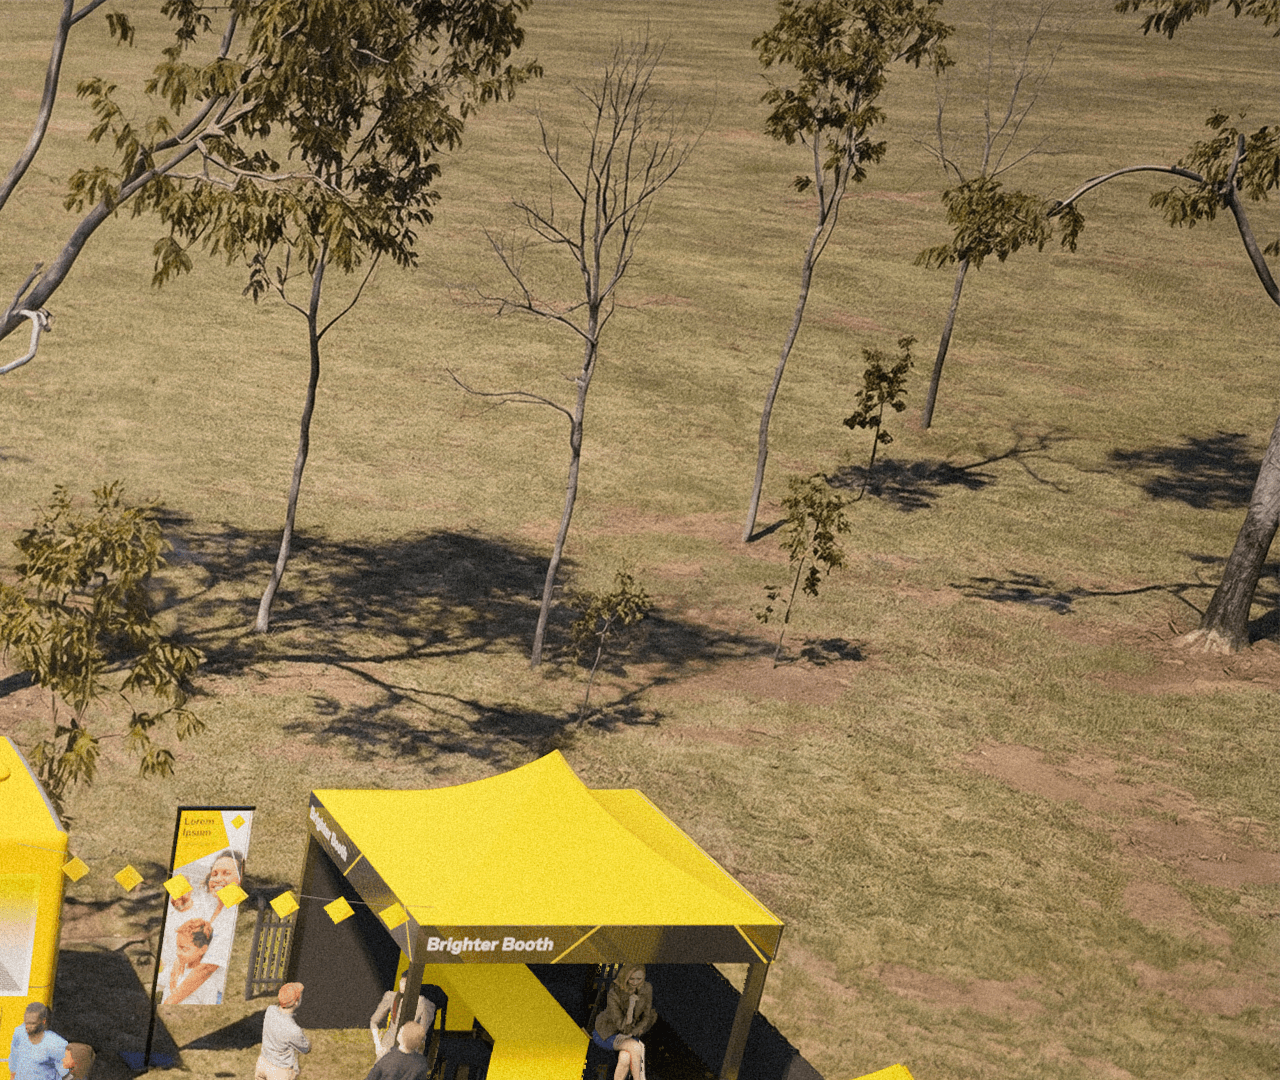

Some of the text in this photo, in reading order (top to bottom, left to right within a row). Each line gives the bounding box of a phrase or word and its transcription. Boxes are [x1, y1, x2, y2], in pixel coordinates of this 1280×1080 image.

[184, 817, 215, 826] Lorem
[182, 828, 212, 838] Ipsum
[426, 936, 554, 955] Brighter Booth
